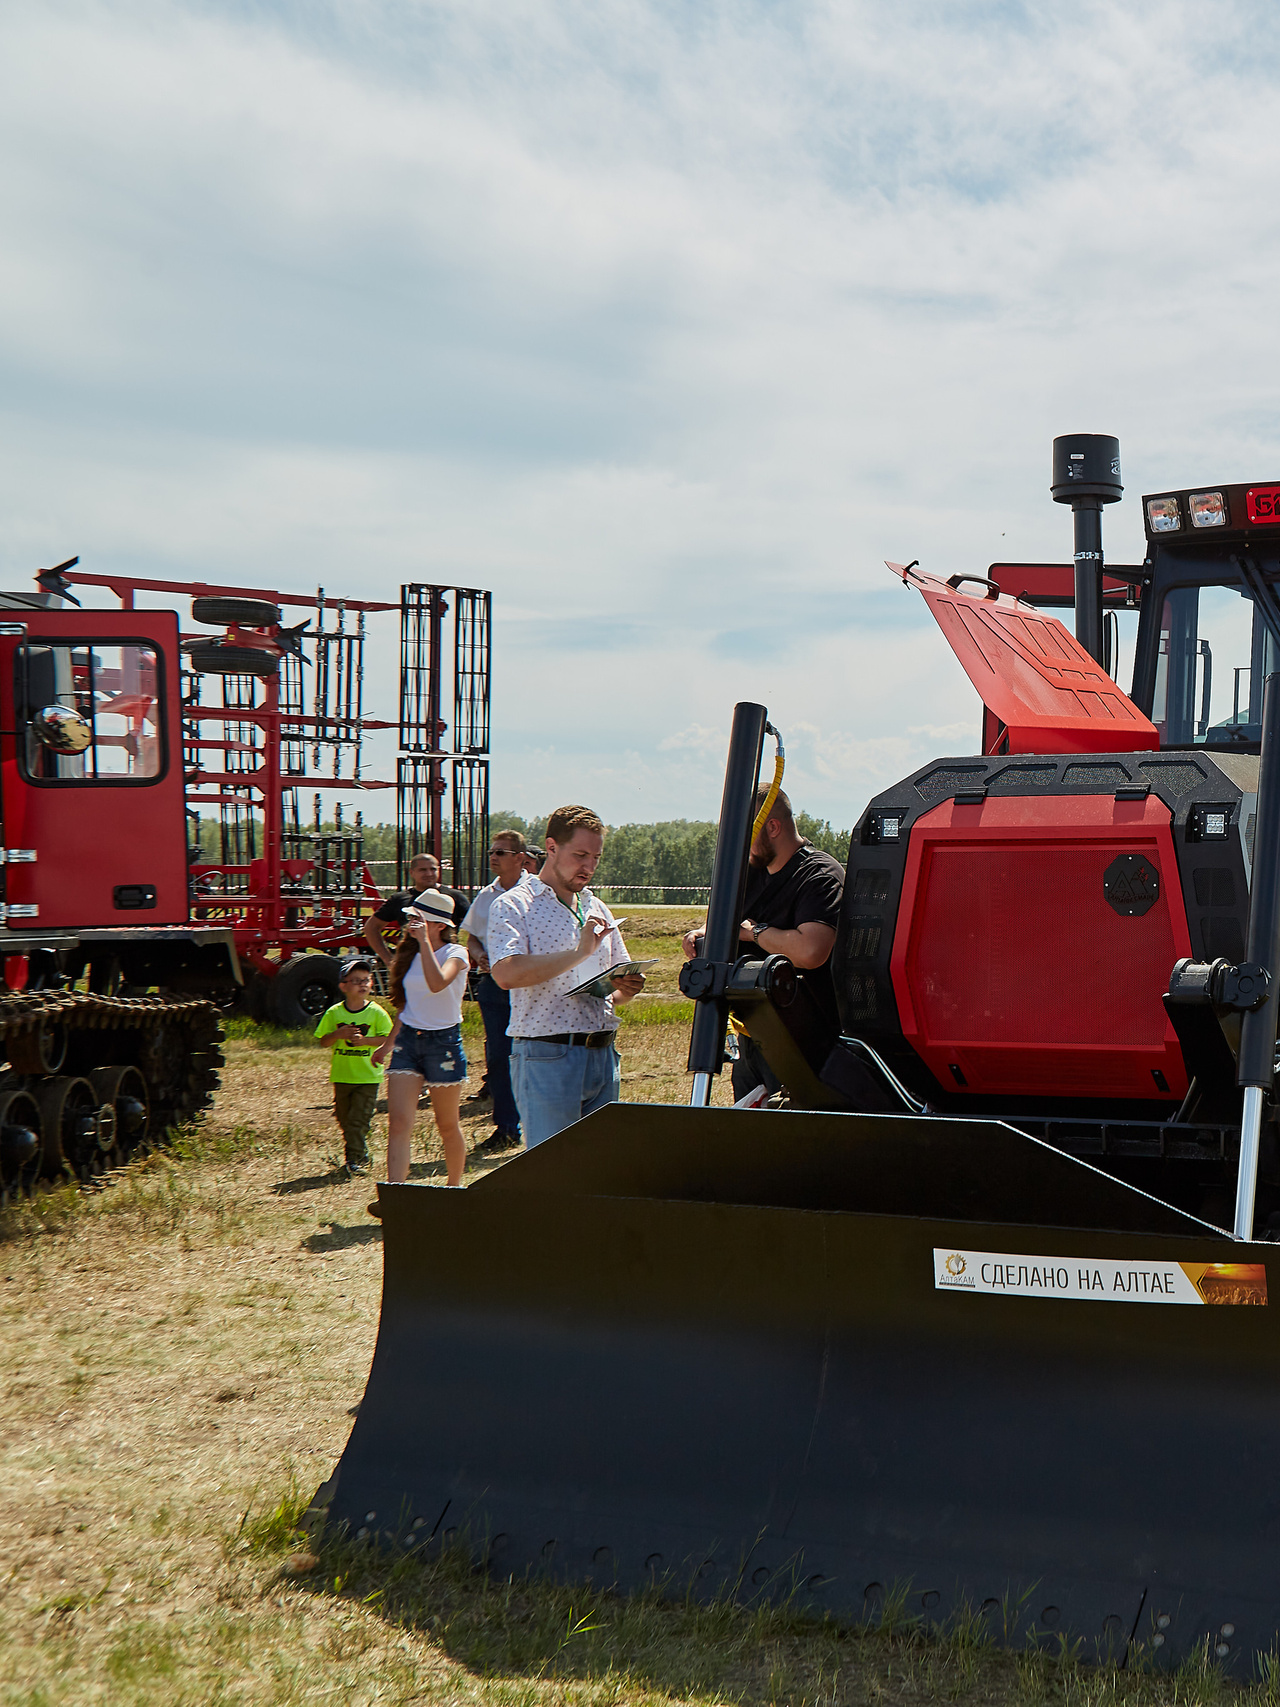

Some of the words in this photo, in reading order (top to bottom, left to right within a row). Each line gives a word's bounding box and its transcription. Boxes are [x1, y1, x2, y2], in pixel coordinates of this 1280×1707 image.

[980, 1263, 1069, 1289] СДЕЛАНО
[1077, 1269, 1105, 1291] НА
[1112, 1271, 1176, 1294] АЛТАЕ
